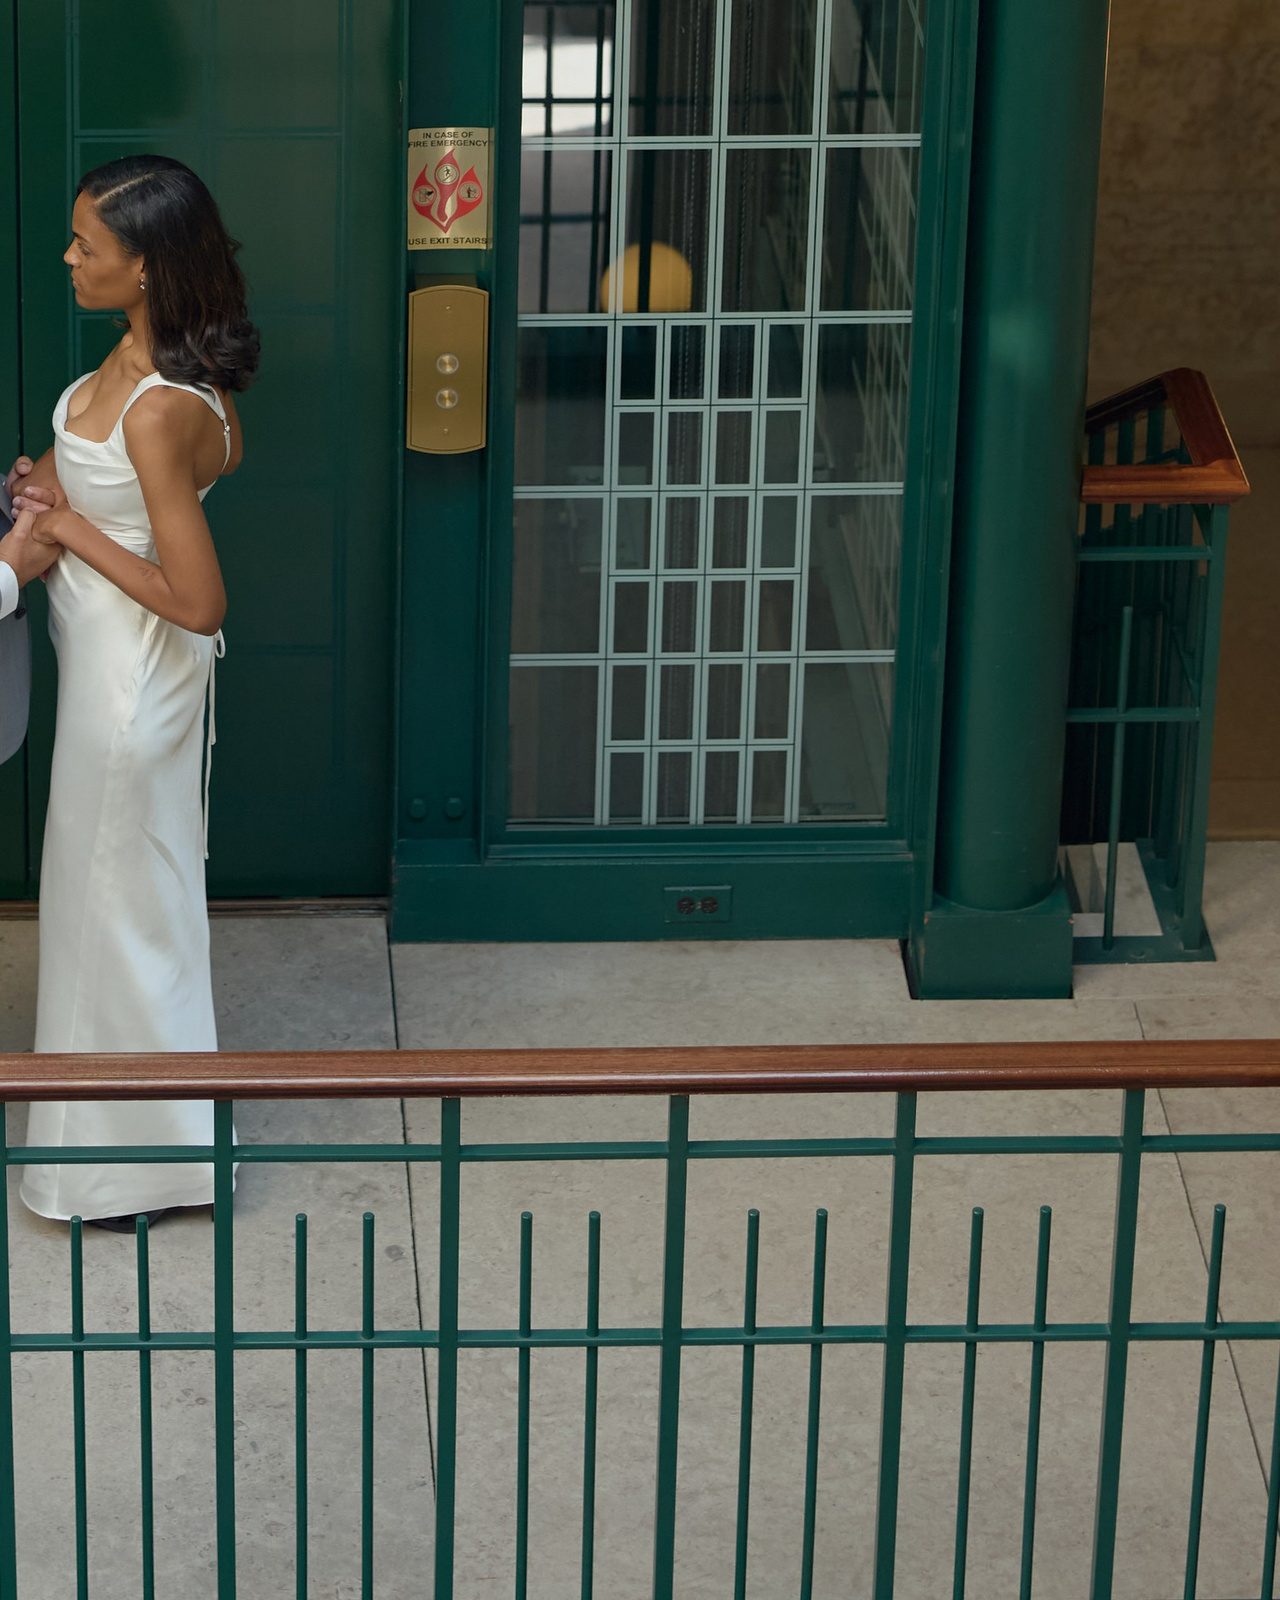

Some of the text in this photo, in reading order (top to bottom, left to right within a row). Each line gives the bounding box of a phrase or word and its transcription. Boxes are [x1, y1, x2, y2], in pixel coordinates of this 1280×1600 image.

[434, 131, 459, 139] CASE
[429, 237, 450, 245] EXIT
[452, 237, 488, 245] STAIRS
